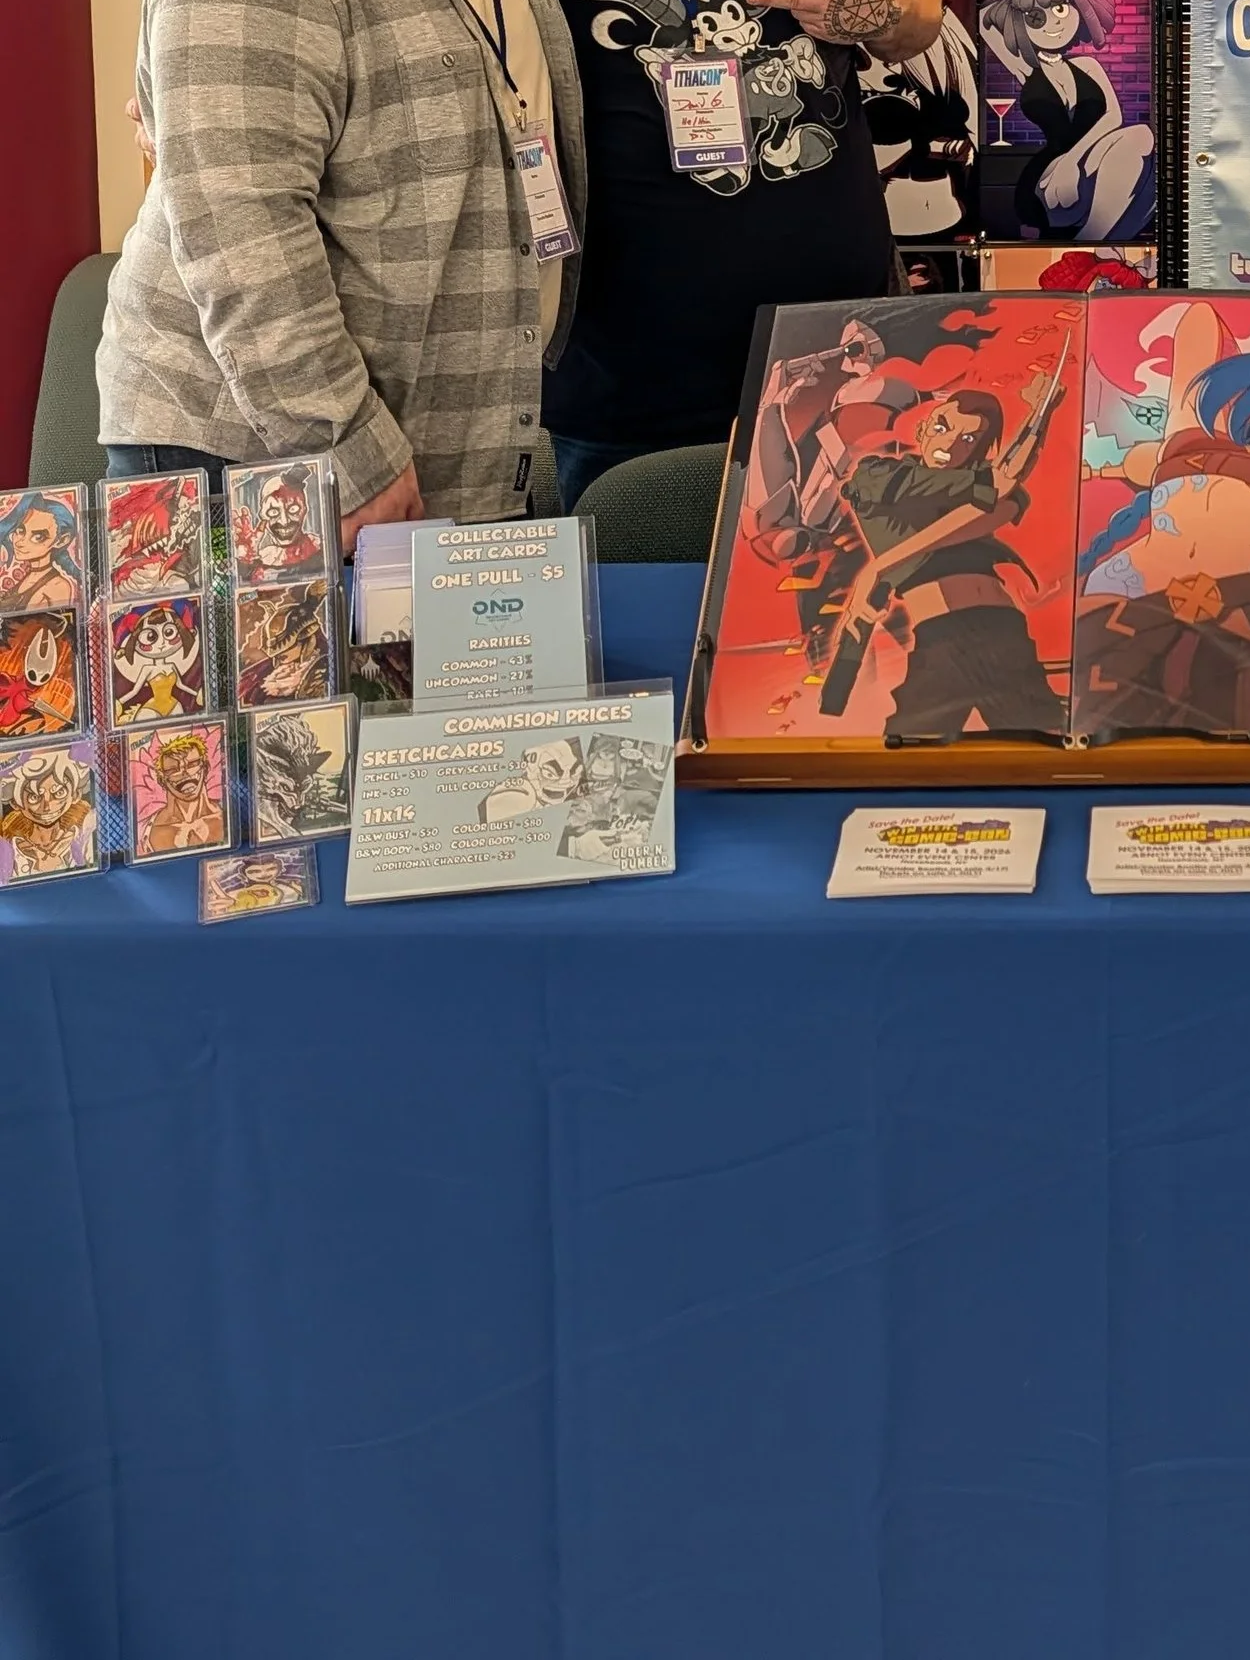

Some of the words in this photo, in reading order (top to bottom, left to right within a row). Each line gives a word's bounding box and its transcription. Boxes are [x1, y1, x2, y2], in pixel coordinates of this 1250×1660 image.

[696, 151, 726, 161] GUEST
[545, 239, 562, 252] GUEST
[437, 524, 557, 546] COLLECTABLE
[449, 547, 483, 562] ART
[487, 543, 548, 559] CARDS
[431, 572, 472, 589] ONE
[478, 569, 523, 586] PULL
[541, 564, 565, 582] $5
[472, 598, 524, 615] OND
[469, 634, 532, 651] RARITIES
[441, 657, 497, 672] COMMON
[425, 673, 498, 689] UNCOMMON
[466, 689, 500, 701] RARE
[443, 710, 561, 735] COMMISION
[565, 704, 633, 726] PRICES
[361, 741, 505, 767] SKETCHCARDS
[364, 771, 400, 783] PENCIL
[409, 769, 428, 780] $10
[436, 766, 464, 778] GREY
[466, 762, 499, 776] SCALE
[362, 790, 380, 800] INK
[390, 787, 410, 798] $20
[436, 783, 459, 794] FULL
[462, 779, 496, 791] COLOR
[362, 804, 417, 825] 11x14
[868, 820, 898, 829] Save
[900, 816, 920, 825] the
[922, 813, 955, 822] Date!
[358, 833, 383, 843] B&W
[385, 829, 410, 840] BUST
[419, 827, 439, 838] $50
[452, 822, 488, 835] COLOR
[490, 820, 514, 832] BUST
[450, 837, 486, 851] COLOR
[488, 834, 517, 847] BODY
[526, 831, 551, 843] $100
[355, 848, 381, 859] B&W
[383, 844, 413, 857] BODY
[864, 847, 930, 855] NOVEMBER
[373, 858, 431, 873] ADDITIONAL
[433, 853, 490, 867] CHARACTER
[620, 855, 669, 872] DUMBER
